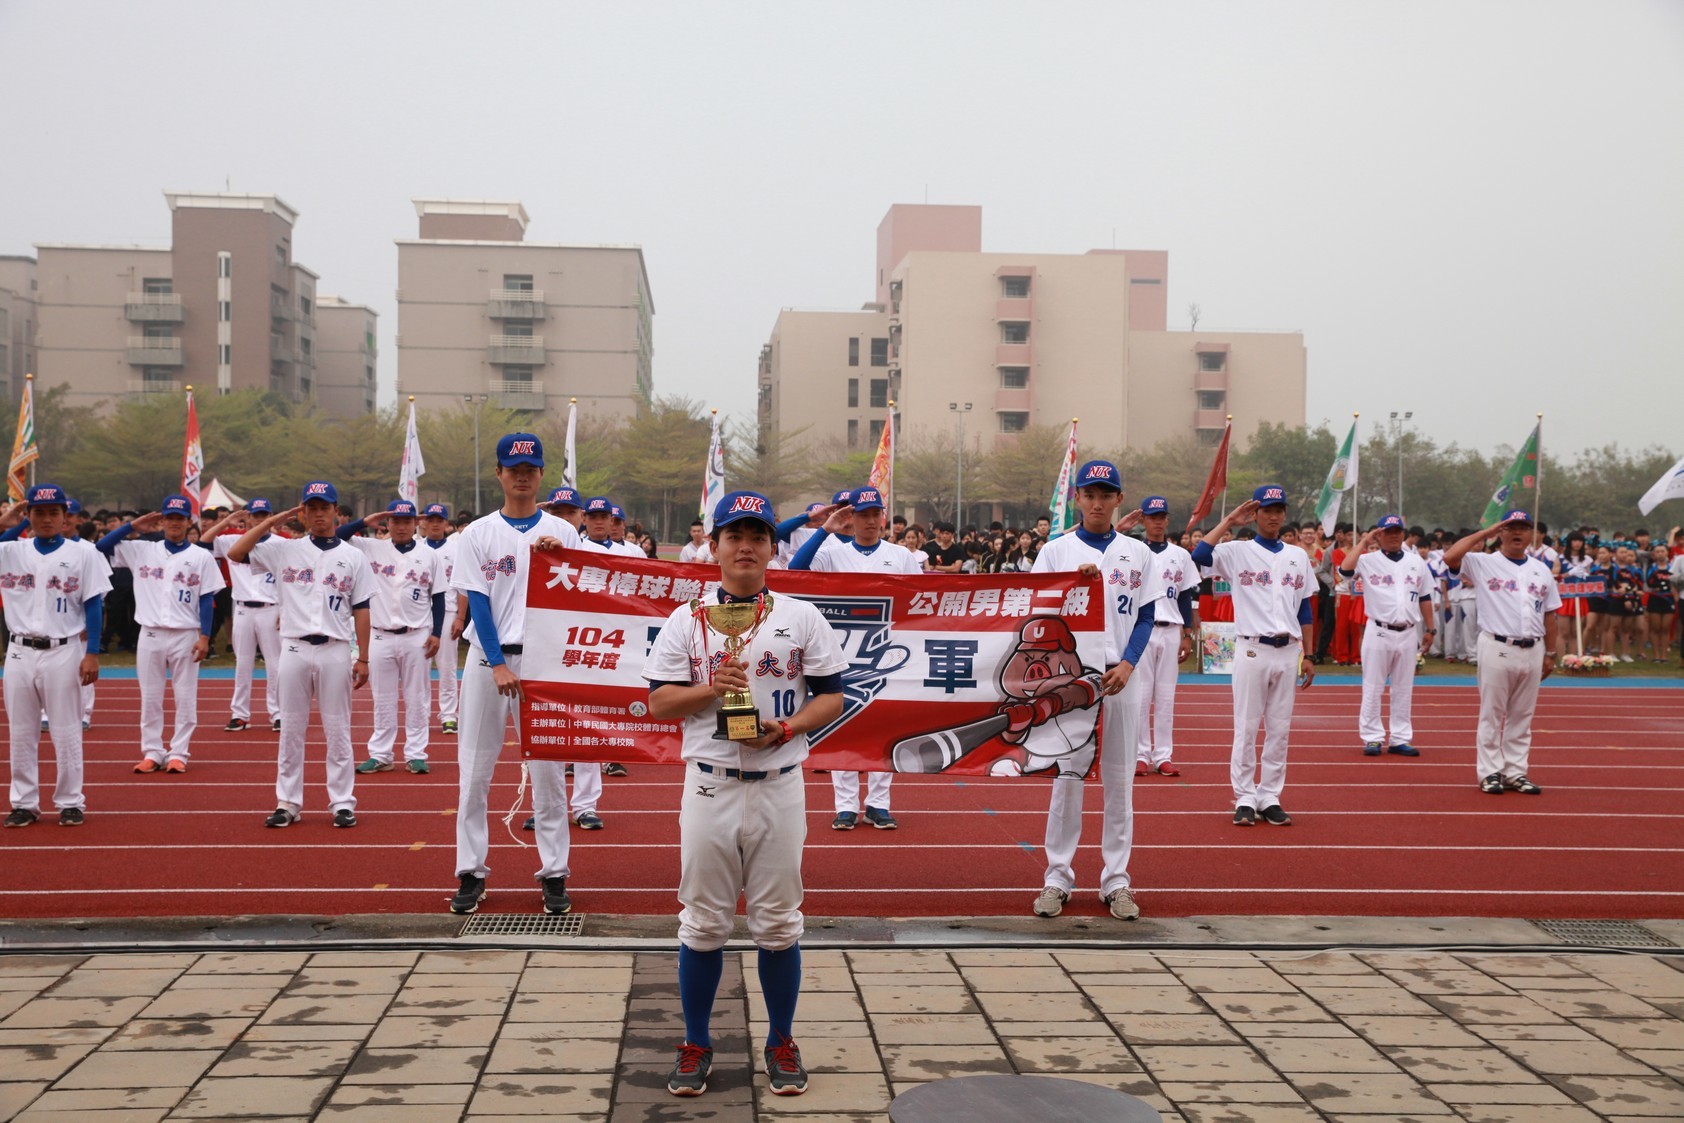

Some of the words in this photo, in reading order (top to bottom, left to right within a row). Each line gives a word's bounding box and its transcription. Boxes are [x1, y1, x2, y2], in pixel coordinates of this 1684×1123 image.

[178, 589, 191, 603] 13
[412, 588, 421, 601] 5
[907, 587, 1090, 618] 公開男第二級
[56, 597, 67, 613] 11
[329, 595, 342, 611] 17
[566, 626, 625, 648] 104
[1033, 626, 1045, 639] U
[562, 649, 620, 670] 學年度
[923, 639, 979, 694] 軍
[531, 703, 566, 712] 指導單位
[573, 704, 626, 715] 教育部體育署
[772, 689, 795, 717] 10
[531, 719, 566, 728] 主辦單位
[573, 720, 678, 733] 中華民國大專院校體育總會
[573, 736, 635, 747] 全國各大專校院
